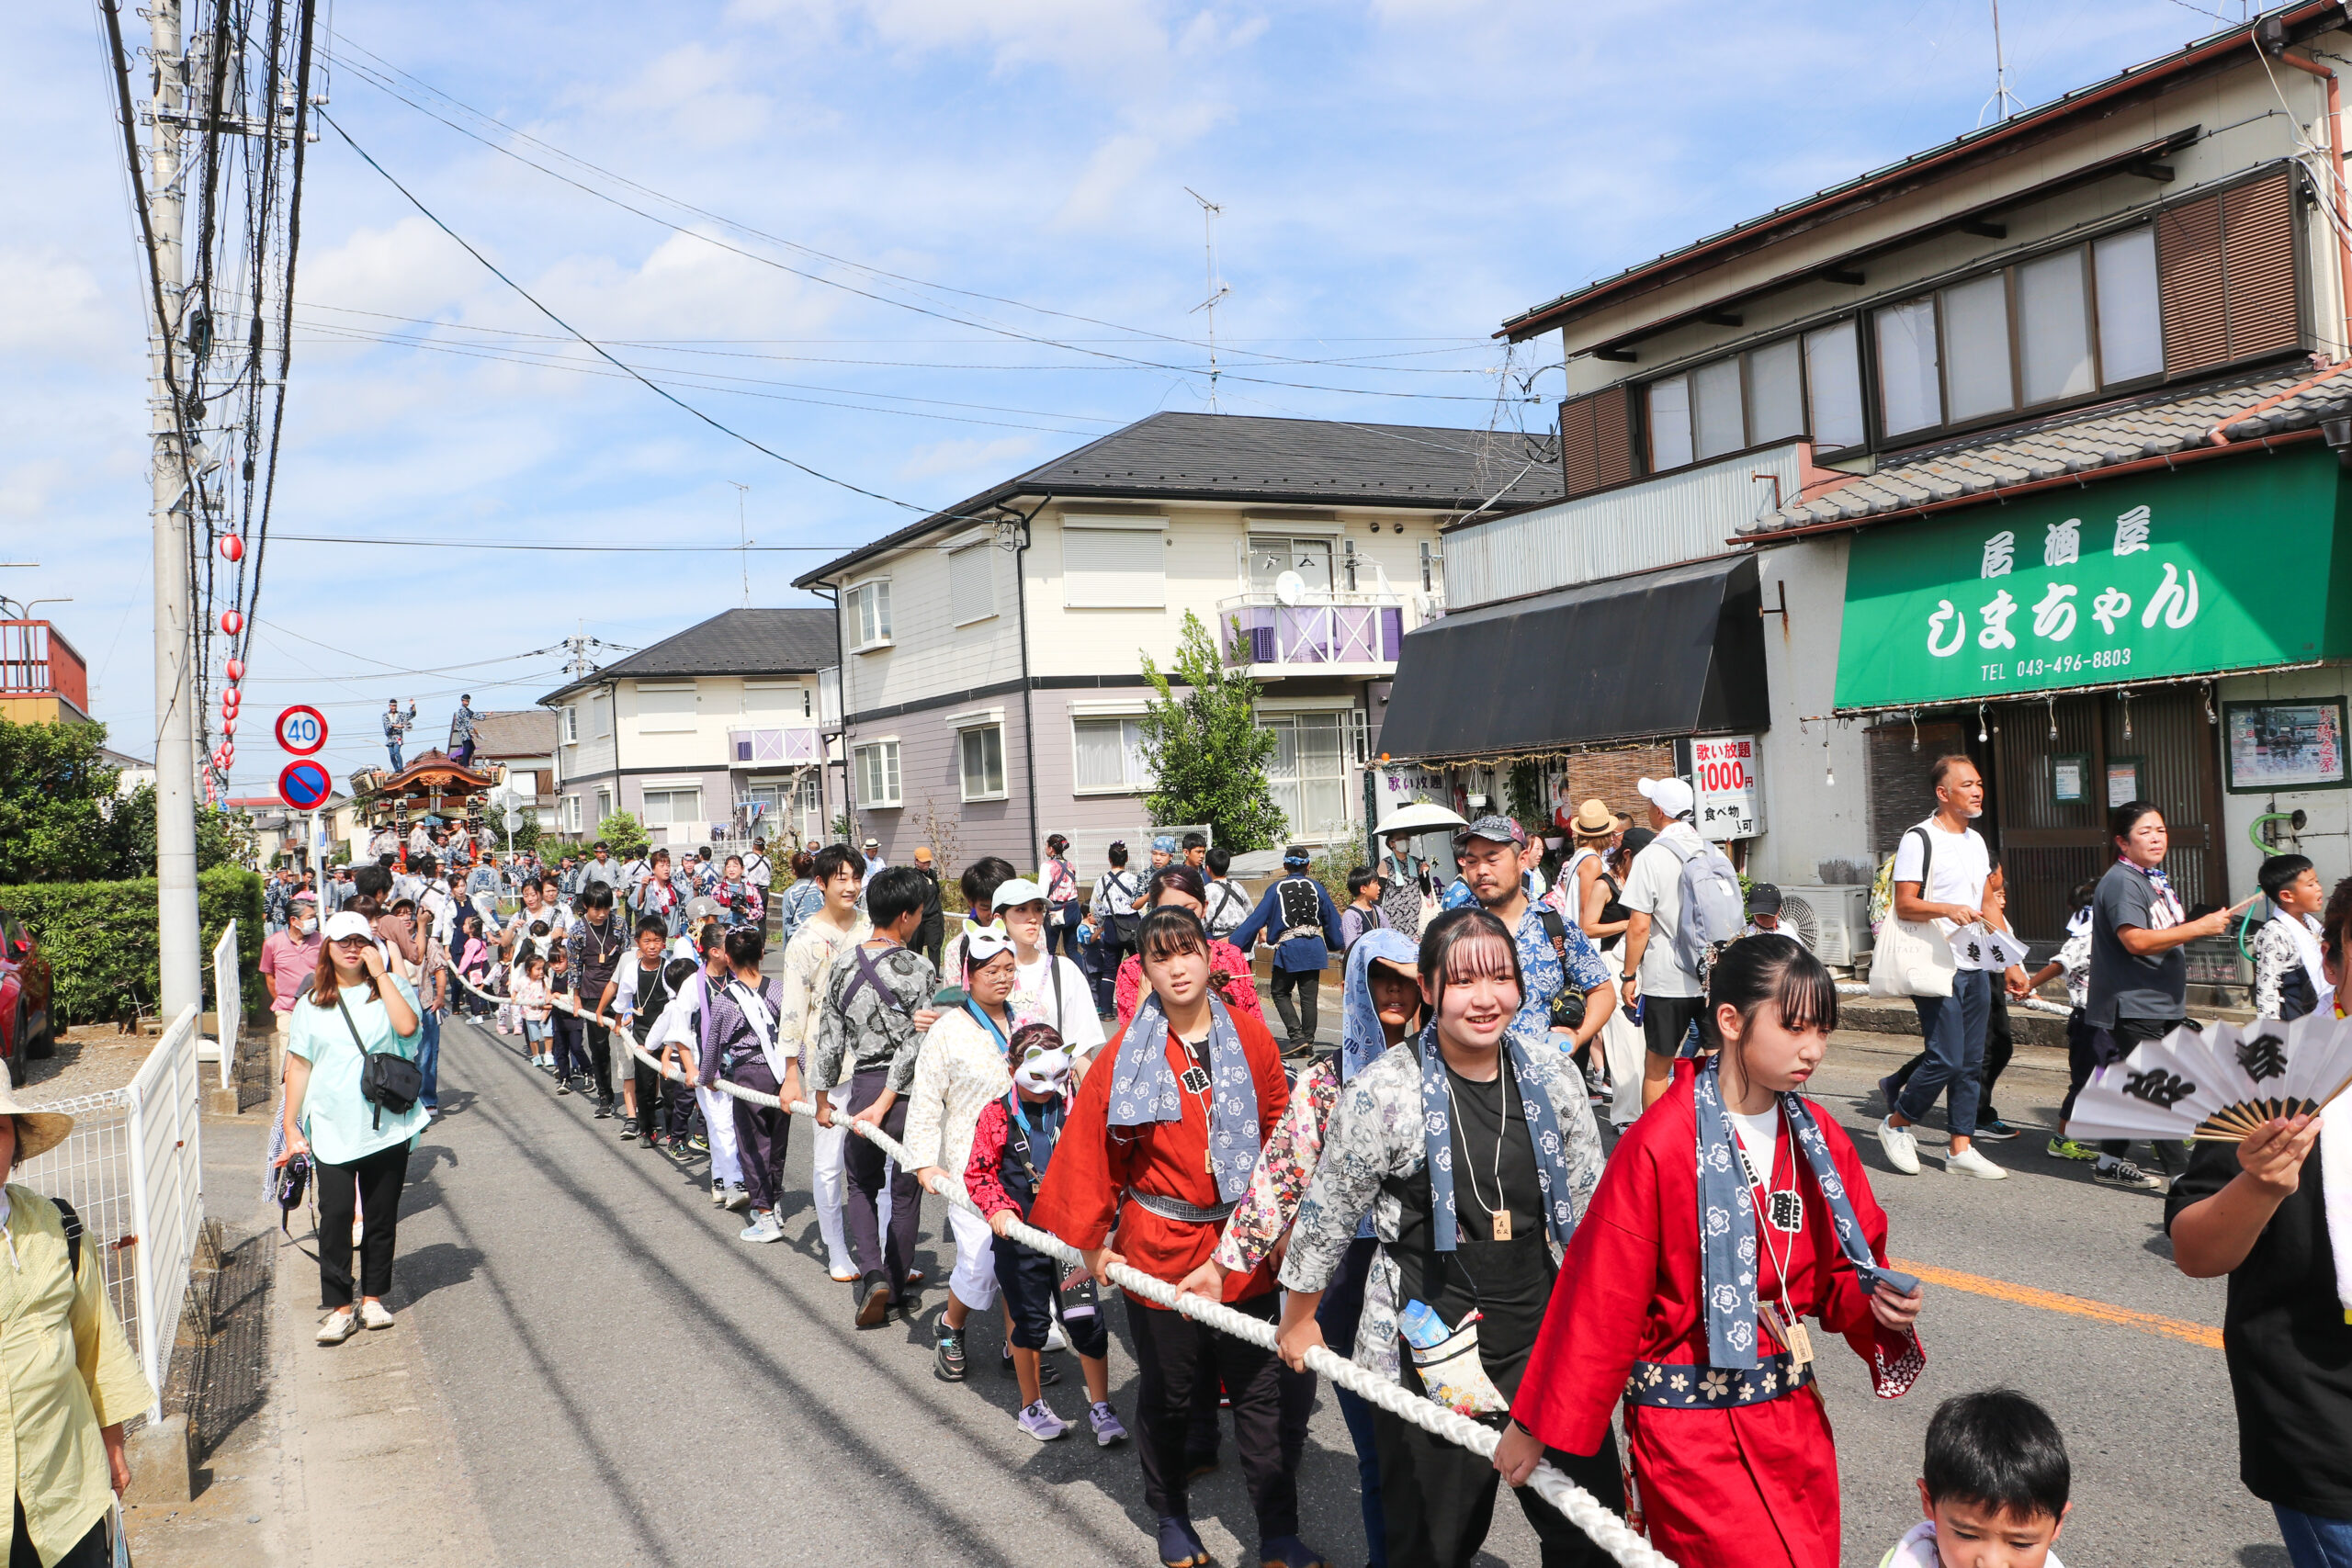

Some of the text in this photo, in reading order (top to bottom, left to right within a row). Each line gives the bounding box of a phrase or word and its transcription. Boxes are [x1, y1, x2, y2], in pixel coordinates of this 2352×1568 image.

[1981, 504, 2151, 580] 居酒屋
[1928, 562, 2199, 658] しまちゃん
[1982, 648, 2132, 682] TEL 043-496-8803
[287, 719, 316, 741] 40
[1696, 741, 1751, 761] 歌い放題
[1388, 774, 1442, 792] 歌い放題
[1704, 805, 1740, 822] 食べ物
[698, 905, 707, 916] 3
